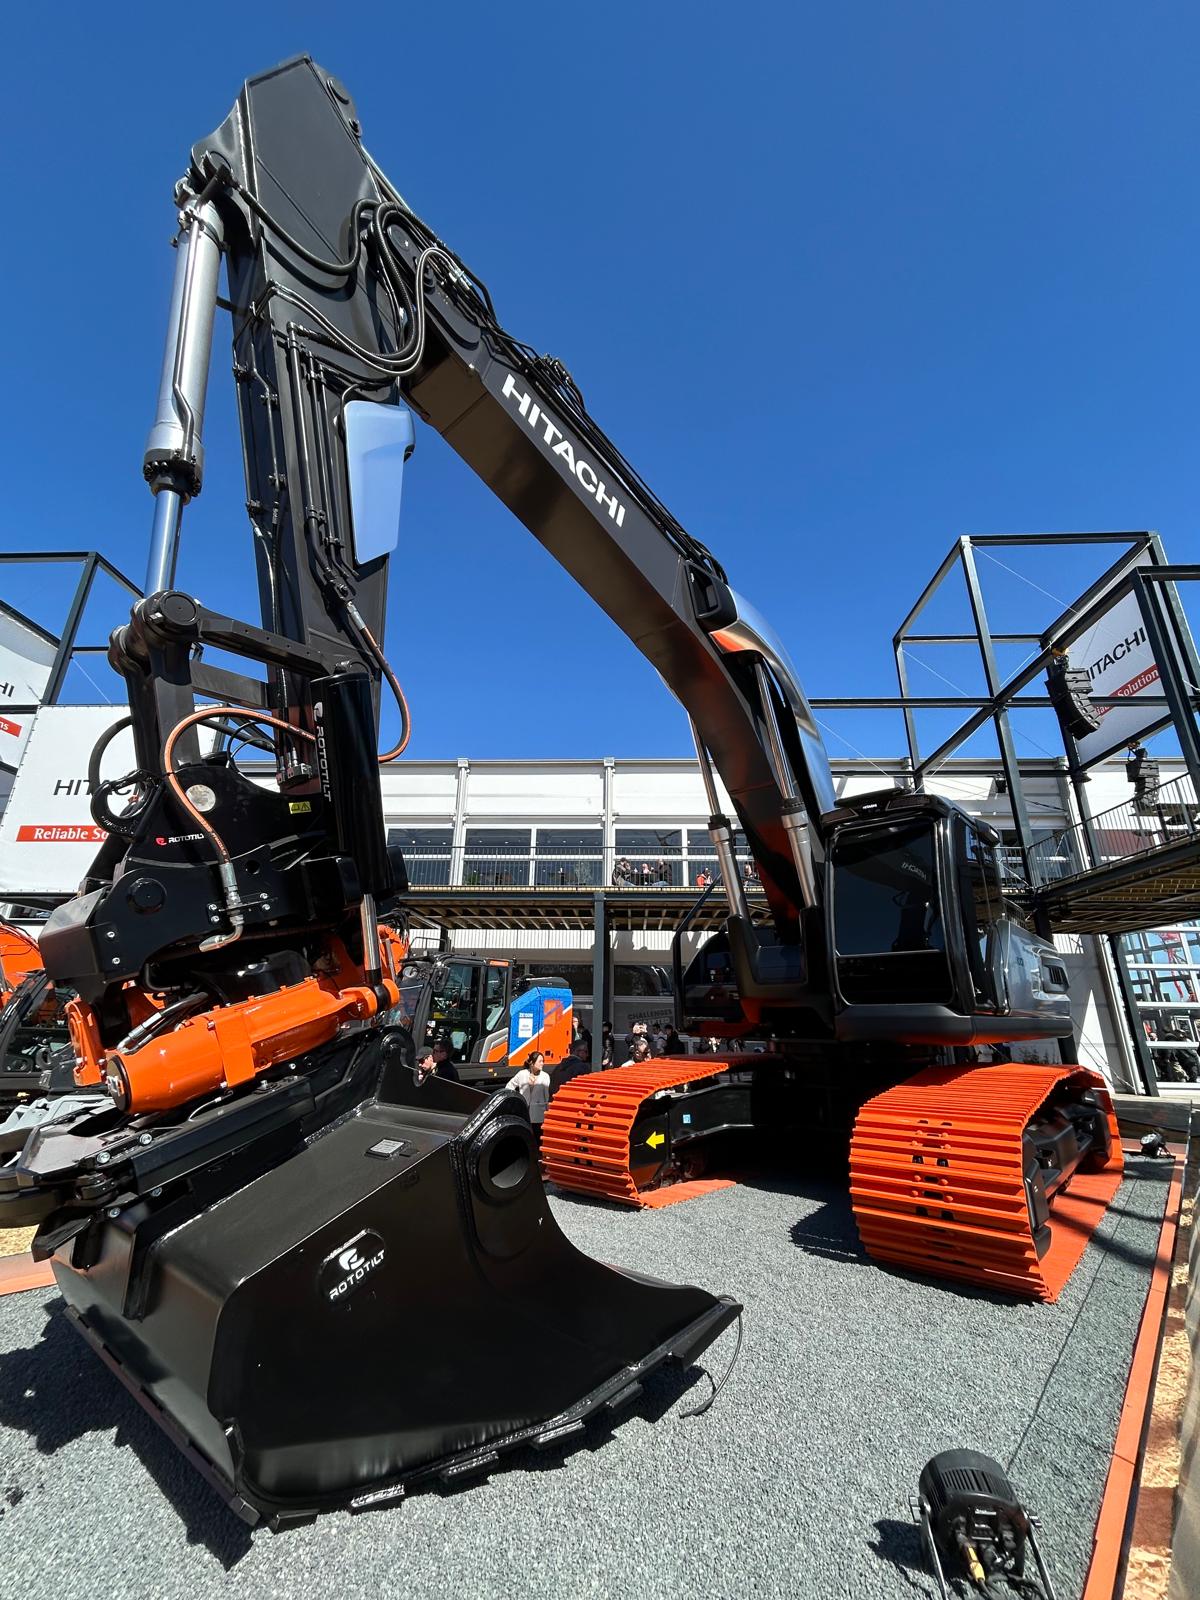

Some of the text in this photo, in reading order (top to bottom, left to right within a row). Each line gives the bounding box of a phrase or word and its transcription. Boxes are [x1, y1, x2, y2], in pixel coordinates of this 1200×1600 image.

[501, 373, 626, 527] HITACHI
[1087, 627, 1147, 680] ITACHI
[316, 726, 332, 802] ROTOTILT
[33, 827, 89, 840] Reliable
[329, 1249, 385, 1300] ROTOTILT
